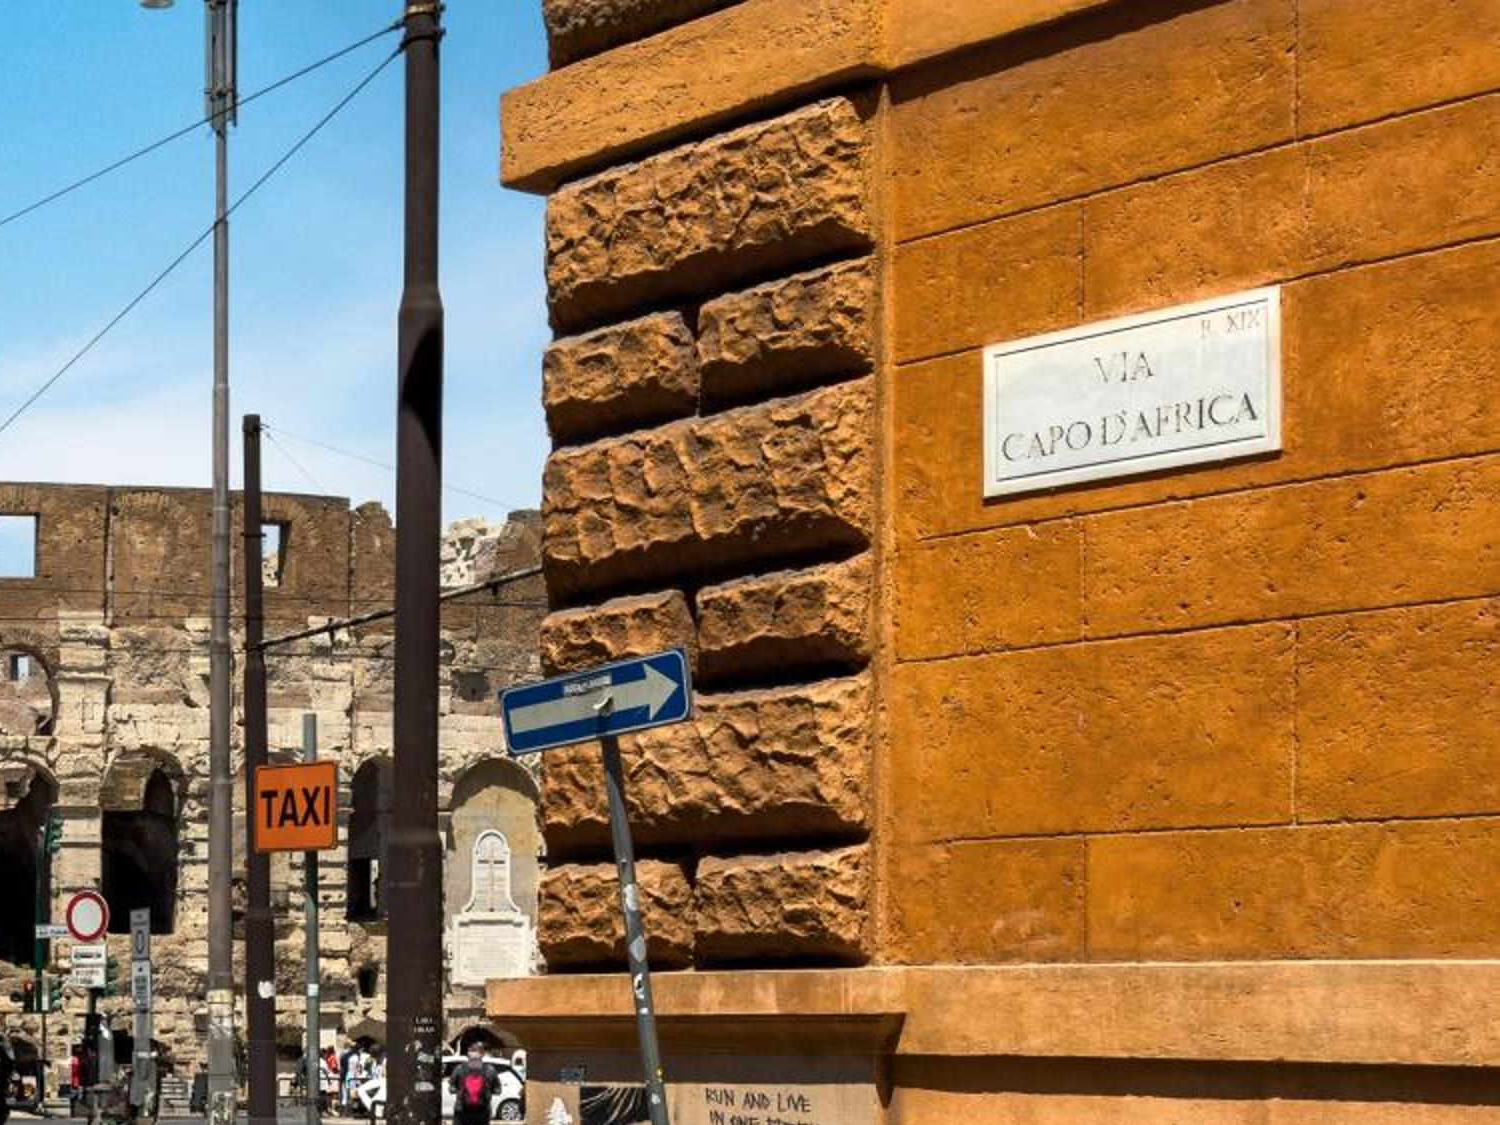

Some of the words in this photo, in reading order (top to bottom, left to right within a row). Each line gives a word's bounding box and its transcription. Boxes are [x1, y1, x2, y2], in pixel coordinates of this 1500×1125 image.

[1094, 351, 1154, 384] VIA
[1001, 420, 1093, 462] CAPO
[1100, 391, 1259, 446] D'AFRICA
[261, 785, 331, 829] TAXI
[743, 1092, 771, 1111] AND
[777, 1093, 812, 1113] LIVE
